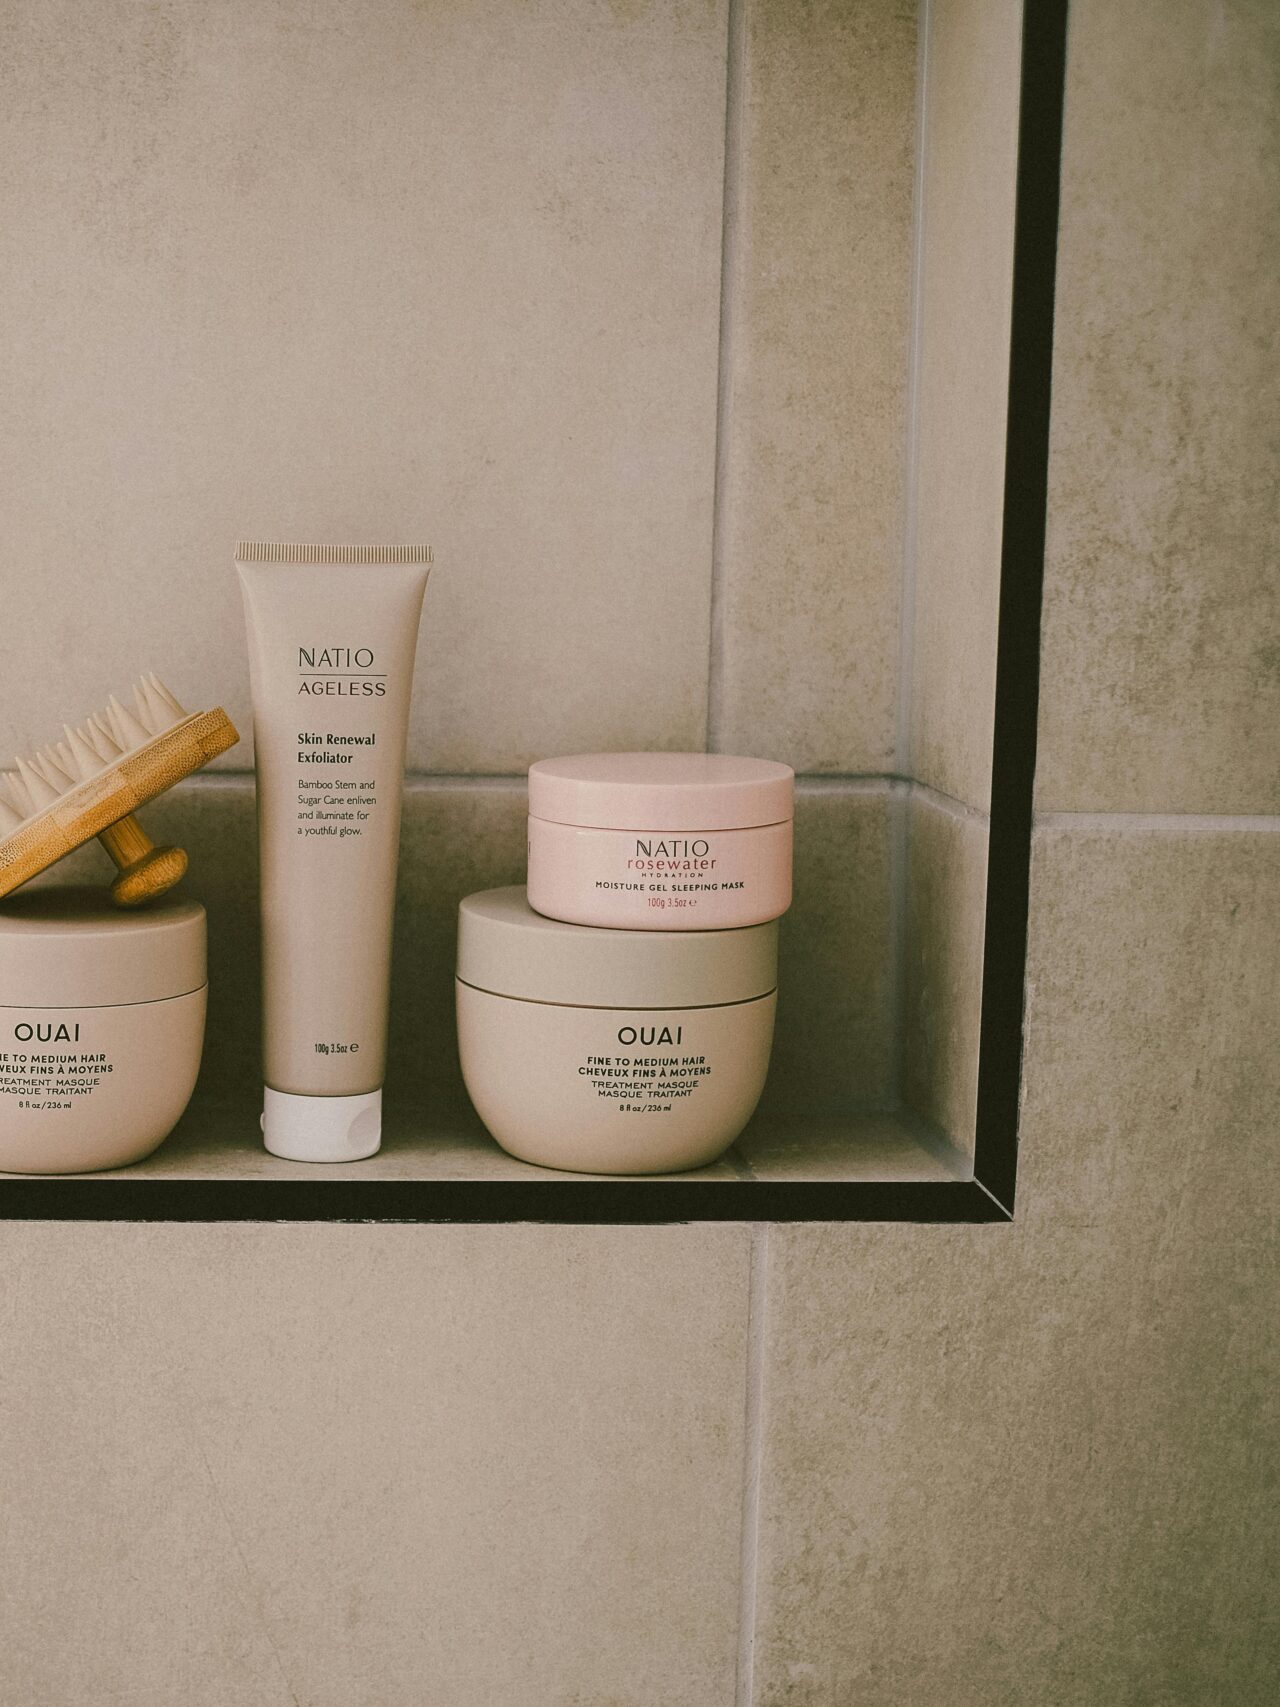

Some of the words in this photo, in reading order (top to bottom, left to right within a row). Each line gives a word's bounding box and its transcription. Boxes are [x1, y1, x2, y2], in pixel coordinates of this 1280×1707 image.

[298, 647, 374, 668] NATIO
[298, 681, 386, 697] AGELESS
[297, 733, 323, 745] Skin
[326, 733, 376, 746] Renewal
[297, 752, 354, 764] Exfoliator
[298, 780, 333, 790] Bamboo
[335, 780, 357, 790] Stem
[359, 780, 375, 790] and
[297, 795, 322, 807] Sugar
[323, 795, 345, 805] Cane
[346, 795, 377, 805] enliven
[297, 811, 314, 820] and
[315, 810, 354, 820] illuminate
[356, 810, 370, 820] for
[297, 827, 303, 835] a
[304, 826, 338, 837] youthful
[339, 826, 362, 838] glow.
[636, 839, 709, 858] NATIO
[627, 857, 717, 870] rosewater
[595, 881, 645, 891] MOISTURE
[649, 884, 668, 892] GEL
[672, 883, 718, 892] SLEEPING
[721, 881, 745, 890] MASK
[647, 898, 665, 909] 100g
[667, 898, 687, 907] 3.5oz
[14, 1023, 80, 1043] OUAI
[617, 1026, 682, 1046] OUAI
[314, 1043, 329, 1055] 100g
[330, 1043, 348, 1053] 3.5oz
[12, 1054, 27, 1063] TO
[30, 1054, 77, 1063] MEDIUM
[80, 1053, 106, 1062] HAIR
[587, 1056, 612, 1066] FINE
[615, 1058, 630, 1066] TO
[633, 1058, 679, 1067] MEDIUM
[682, 1056, 706, 1065] HAIR
[30, 1066, 54, 1075] FINS
[57, 1064, 65, 1075] À
[69, 1064, 114, 1074] MOYENS
[578, 1067, 629, 1077] CHEVEUX
[632, 1069, 656, 1078] FINS
[659, 1067, 667, 1077] À
[669, 1066, 712, 1077] MOYENS
[56, 1078, 100, 1086] MASQUE
[591, 1080, 653, 1089] TREATMENT
[657, 1080, 699, 1089] MASQUE
[45, 1087, 94, 1095] TRAITANT
[598, 1090, 643, 1098] MASQUE
[647, 1089, 693, 1098] TRAITANT
[25, 1100, 31, 1108] fl
[63, 1101, 72, 1109] ml
[619, 1104, 624, 1112] 8
[663, 1103, 672, 1112] ml
